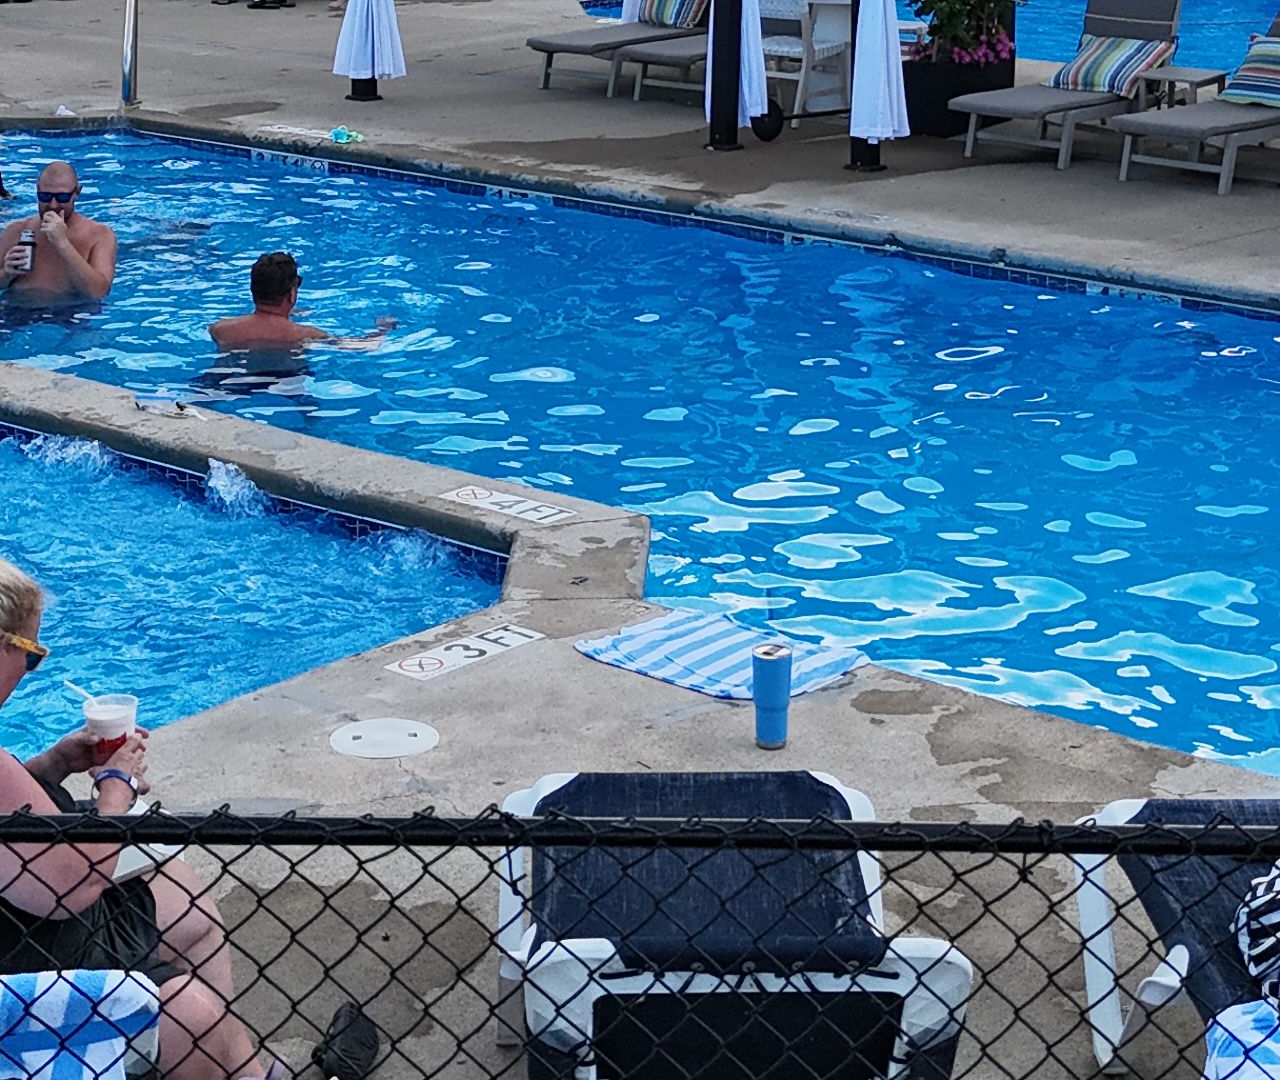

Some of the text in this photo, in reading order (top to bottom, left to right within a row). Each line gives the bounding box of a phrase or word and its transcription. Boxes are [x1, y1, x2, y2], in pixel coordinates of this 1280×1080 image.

[488, 499, 573, 521] 4 FT
[443, 624, 536, 659] 3 FT
